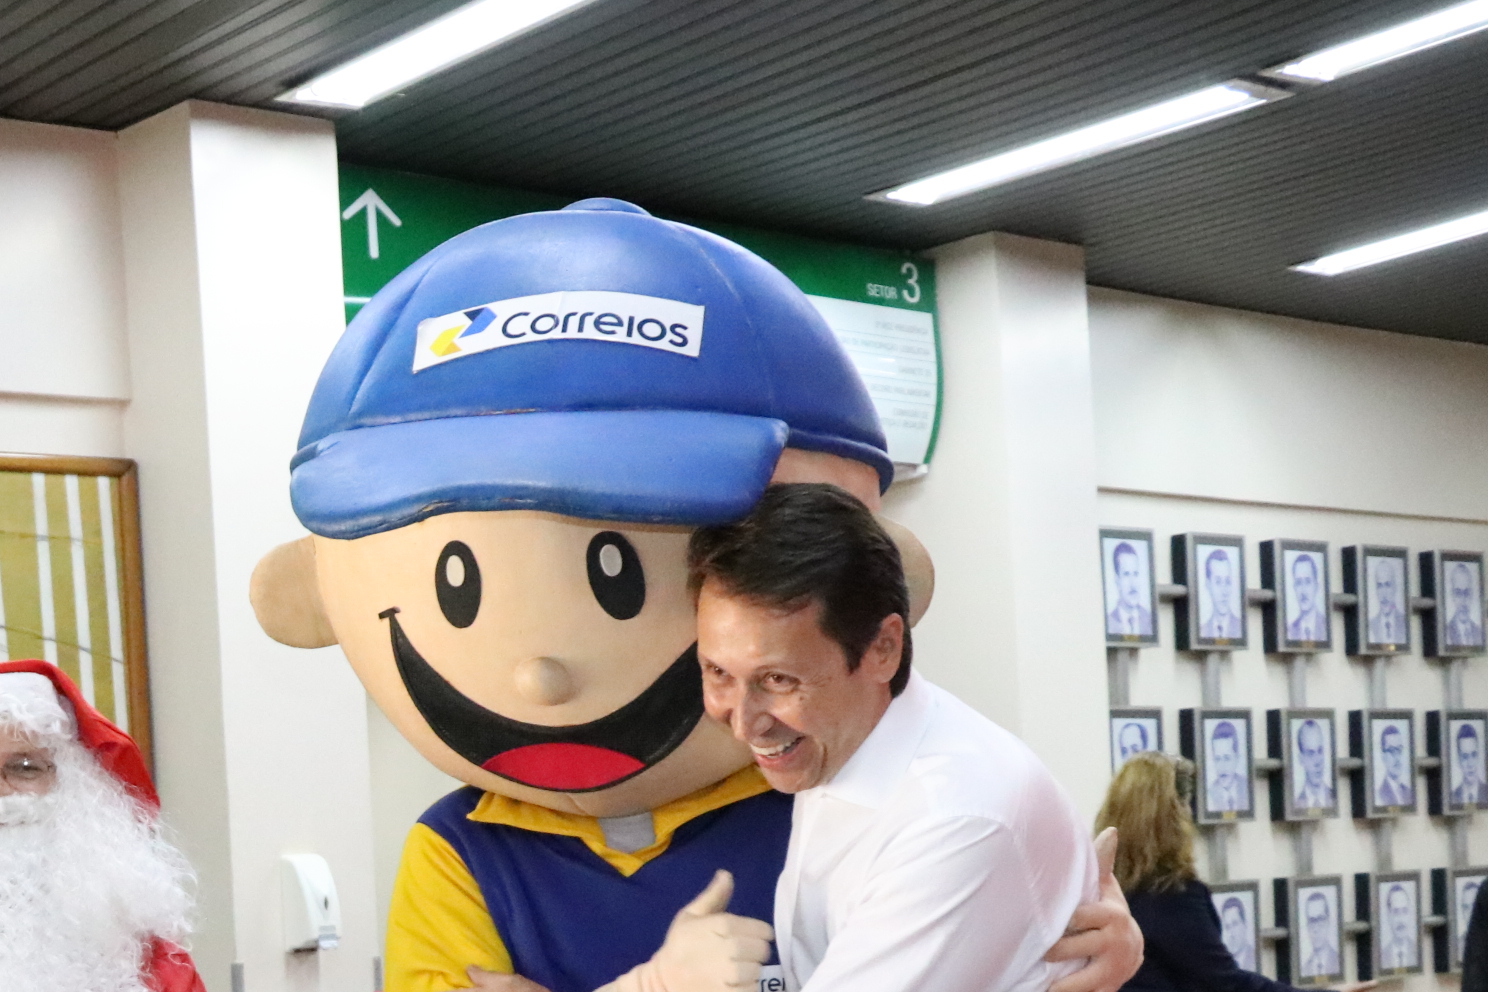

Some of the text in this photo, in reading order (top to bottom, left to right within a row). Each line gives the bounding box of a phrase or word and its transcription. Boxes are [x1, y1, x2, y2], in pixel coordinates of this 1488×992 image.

[867, 262, 920, 303] SETOR 3
[502, 311, 689, 347] Correios
